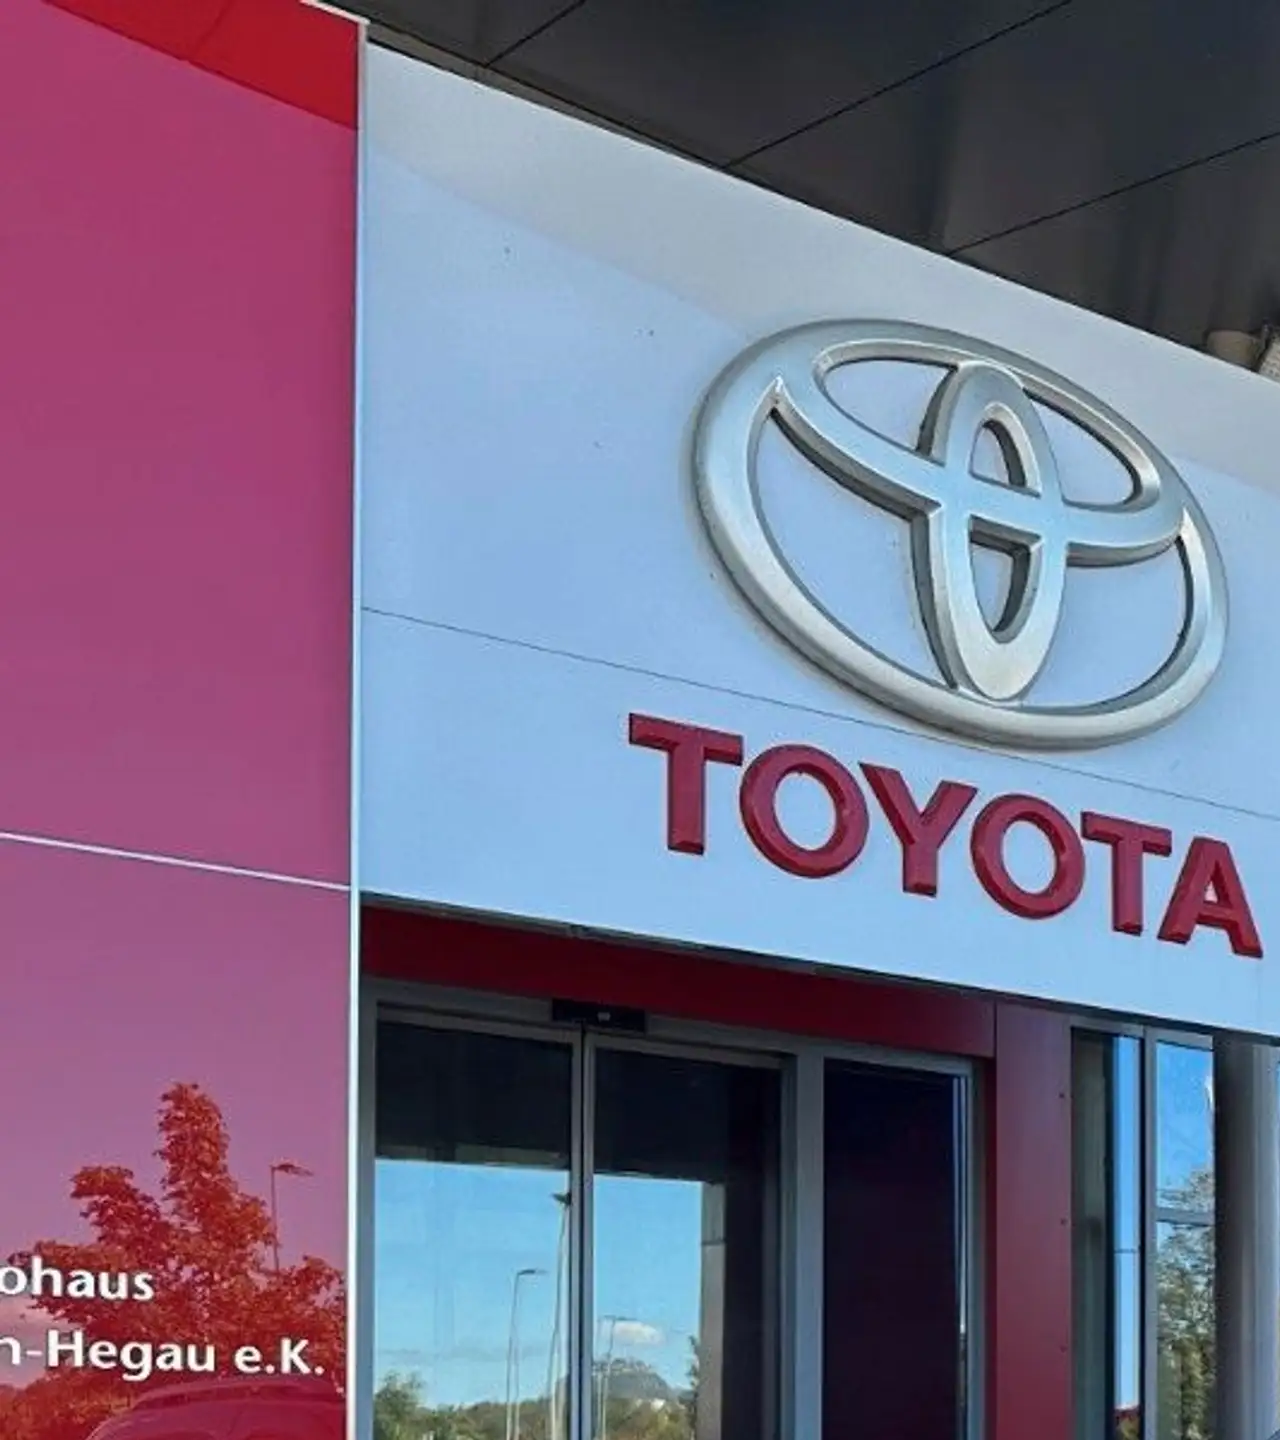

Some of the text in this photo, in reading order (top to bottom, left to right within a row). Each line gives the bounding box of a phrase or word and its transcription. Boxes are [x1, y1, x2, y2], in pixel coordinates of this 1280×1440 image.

[628, 712, 1263, 959] TOYOTA
[0, 1256, 155, 1301] ohaus
[234, 1338, 325, 1375] e.K.
